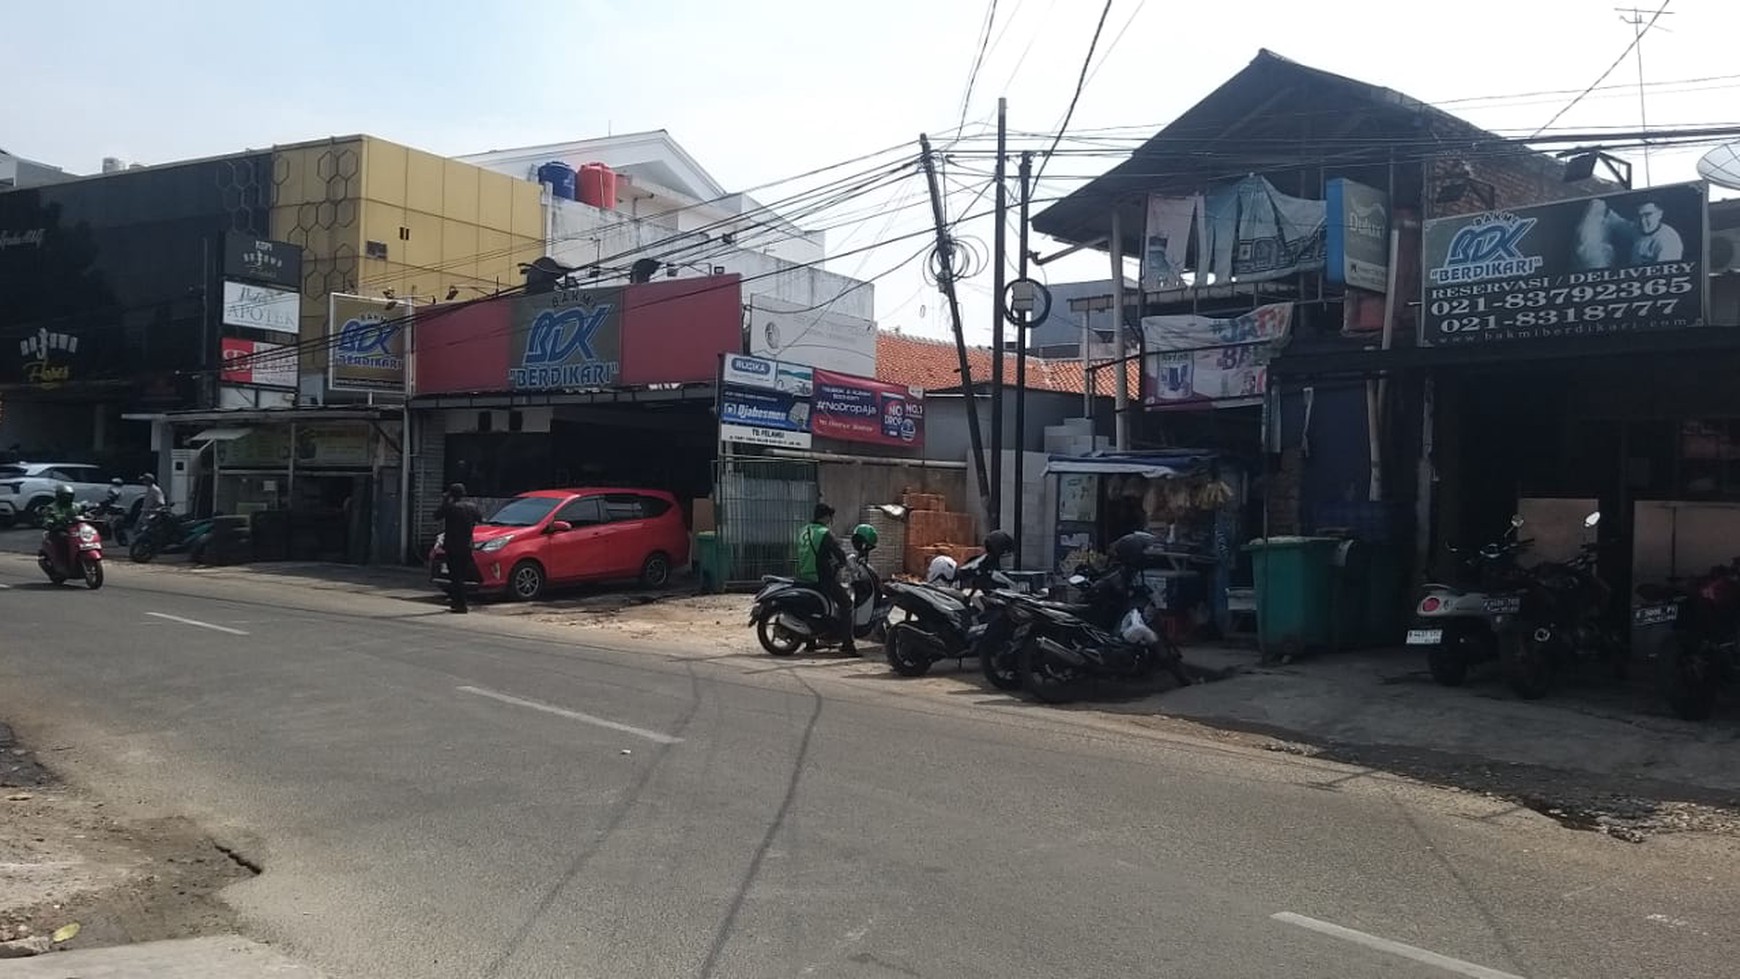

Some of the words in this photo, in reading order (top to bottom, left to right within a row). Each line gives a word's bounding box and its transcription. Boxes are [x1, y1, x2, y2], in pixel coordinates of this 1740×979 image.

[1430, 276, 1693, 316] 021-83792365
[1431, 277, 1550, 299] RESERVASI
[1569, 261, 1697, 285] DELIVERY
[1440, 299, 1680, 333] 021-8318777
[816, 401, 877, 416] #NoDropAja
